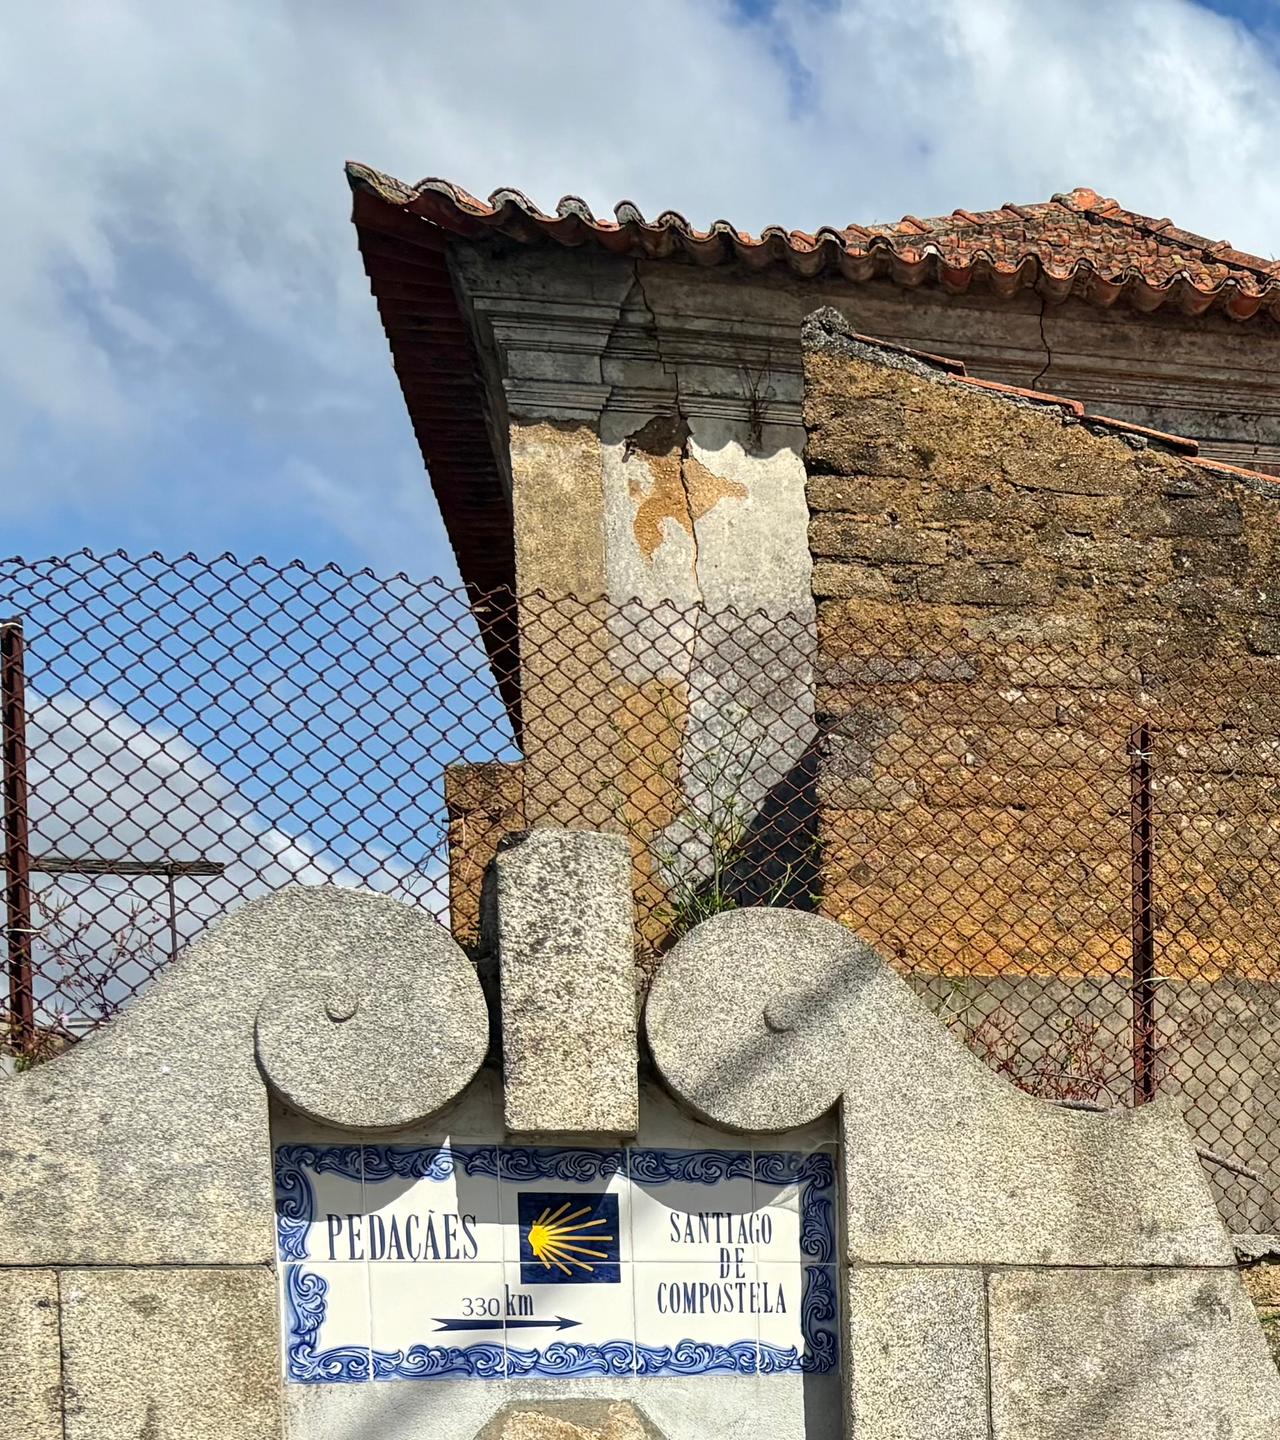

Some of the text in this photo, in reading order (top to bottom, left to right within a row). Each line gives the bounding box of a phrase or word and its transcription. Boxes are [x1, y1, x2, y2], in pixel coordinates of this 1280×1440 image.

[325, 1208, 478, 1263] PEDAÇÃES
[669, 1211, 773, 1244] SANTIAGO
[719, 1247, 746, 1279] DE
[461, 1284, 534, 1317] 330 km
[657, 1282, 787, 1314] COMPOSTELA
